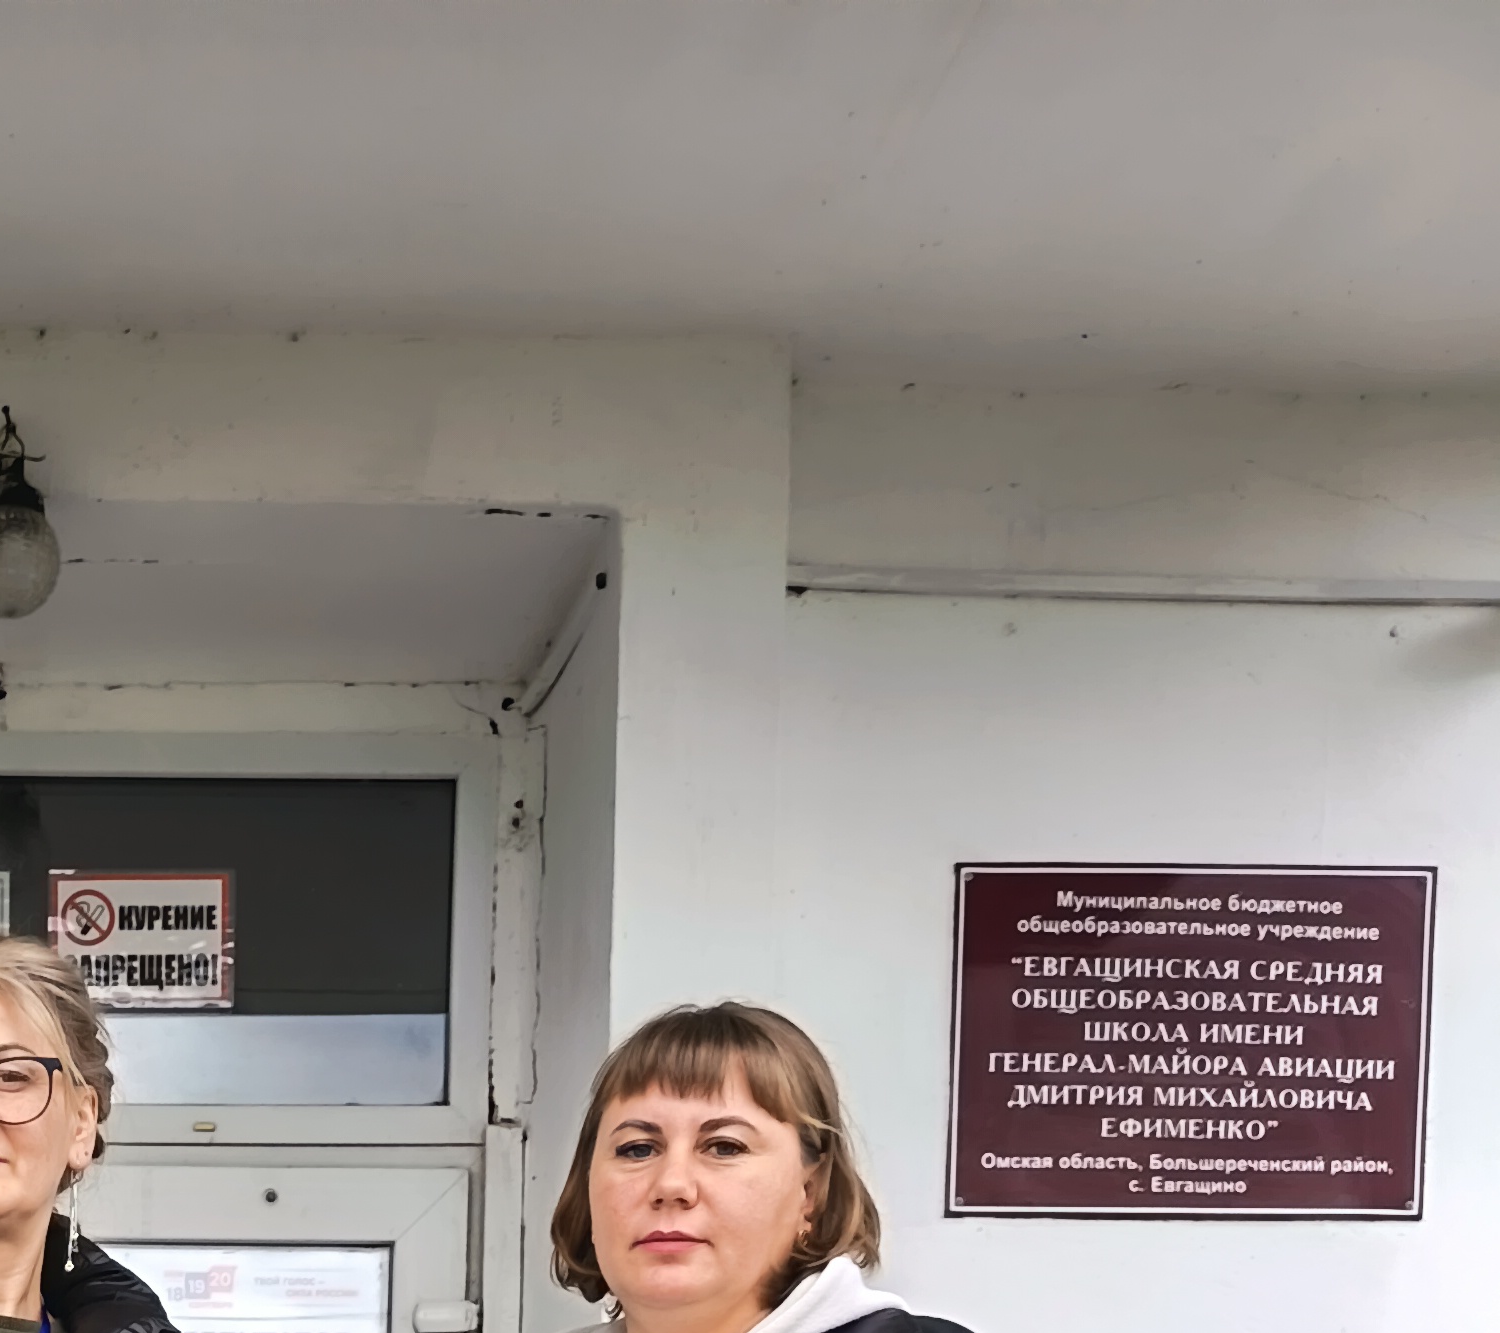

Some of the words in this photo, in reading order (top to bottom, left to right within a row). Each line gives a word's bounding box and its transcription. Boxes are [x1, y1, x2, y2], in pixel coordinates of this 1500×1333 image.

[1056, 890, 1222, 913] Муниципальное
[1227, 893, 1344, 915] бюджетное
[118, 904, 218, 931] КУРЕНИЕ
[1016, 915, 1252, 940] общеобразовательное
[1257, 921, 1381, 942] учреждение
[1249, 958, 1384, 985] СРЕДНЯЯ
[1011, 988, 1379, 1017] ОБЩЕОБРАЗОВАТЕЛЬНАЯ
[1084, 1022, 1189, 1045] ШКОЛА
[1200, 1023, 1304, 1046] ИМЕНИ
[988, 1047, 1248, 1076] ГЕНЕРАЛ-МАЙОРА
[1257, 1058, 1395, 1083] АВИАЦИИ
[1007, 1084, 1144, 1109] ДМИТРИЯ
[1153, 1080, 1373, 1112] МИХАЙЛОВИЧА
[980, 1152, 1054, 1171] Омская
[1059, 1152, 1143, 1173] область,
[1149, 1153, 1324, 1174] Большереченский
[1330, 1156, 1393, 1177] район,
[1129, 1180, 1144, 1193] с.
[1151, 1177, 1247, 1196] Евгащино
[167, 1287, 184, 1302] 18
[188, 1279, 205, 1293] 19
[210, 1271, 231, 1287] 20
